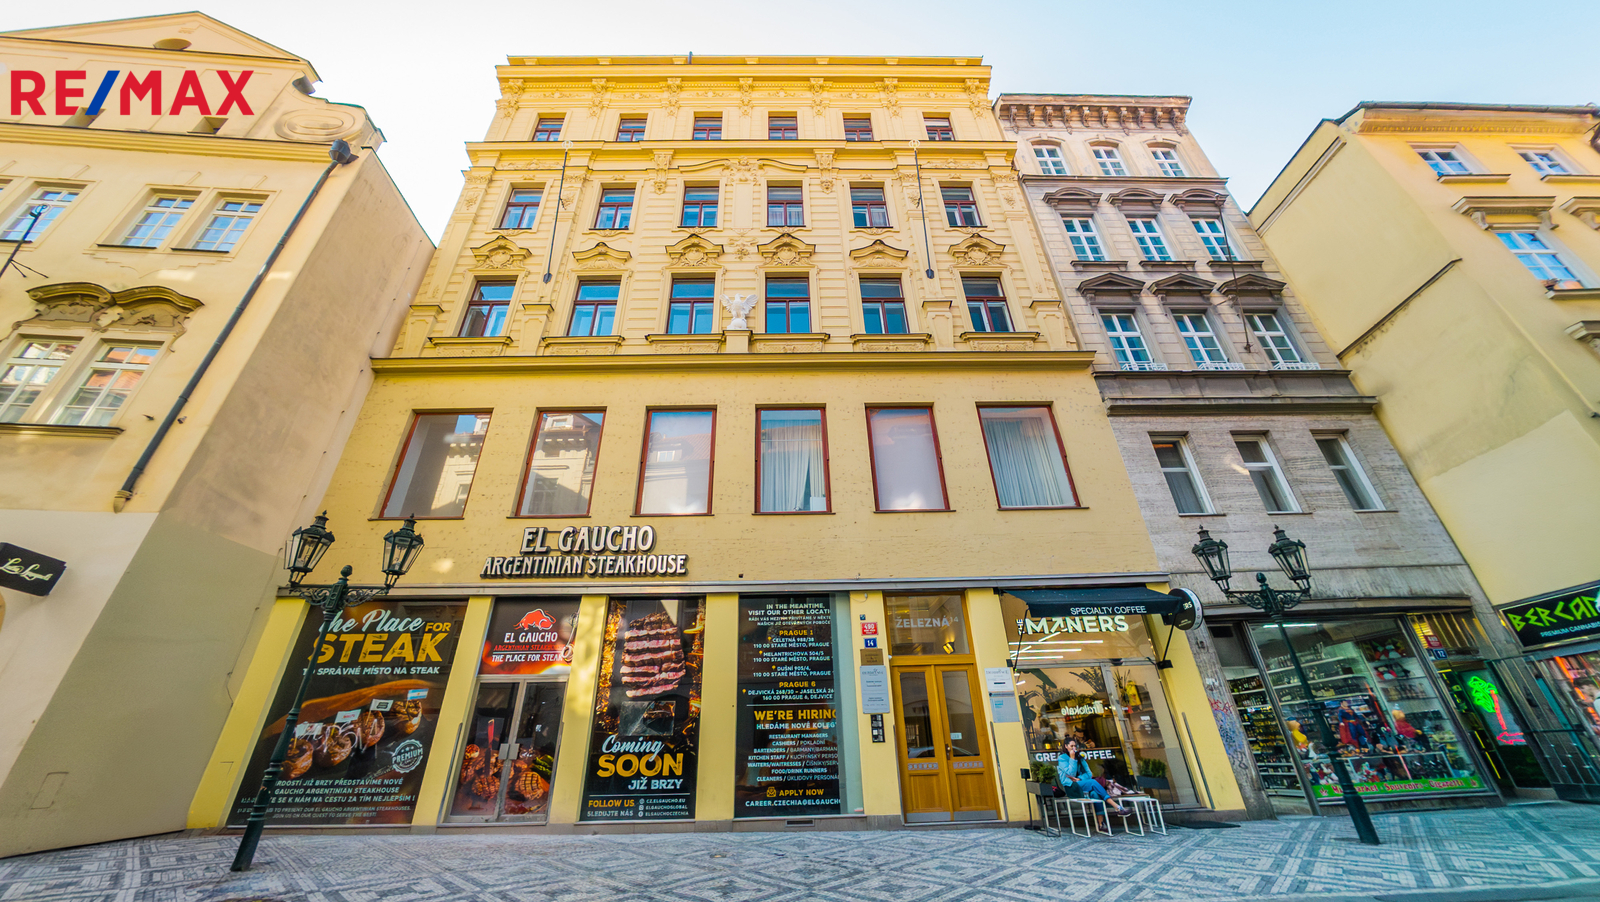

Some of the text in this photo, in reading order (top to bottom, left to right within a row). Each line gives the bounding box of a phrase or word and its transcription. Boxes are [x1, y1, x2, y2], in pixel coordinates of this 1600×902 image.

[521, 525, 655, 552] EL GAUCHO
[481, 555, 688, 576] ARGENTINIAN STEAKHOUSE
[1114, 606, 1146, 614] COFFEE
[362, 609, 425, 632] Place
[425, 622, 451, 632] FOR
[896, 616, 950, 628] ŽELEZNÁ
[504, 632, 558, 642] EL GAUCHO
[1540, 628, 1569, 637] PREMIUM
[308, 633, 449, 663] STEAK
[317, 666, 361, 675] SPRÁVNÉ
[363, 666, 391, 674] MÍSTO
[410, 666, 440, 674] STEAK
[757, 722, 789, 730] HLEDÁME
[602, 735, 664, 761] Coming
[392, 748, 423, 764] PREMIUM
[1080, 750, 1116, 760] OFFEE.
[597, 753, 683, 777] SOON
[628, 777, 683, 790] JIŽ BRZY
